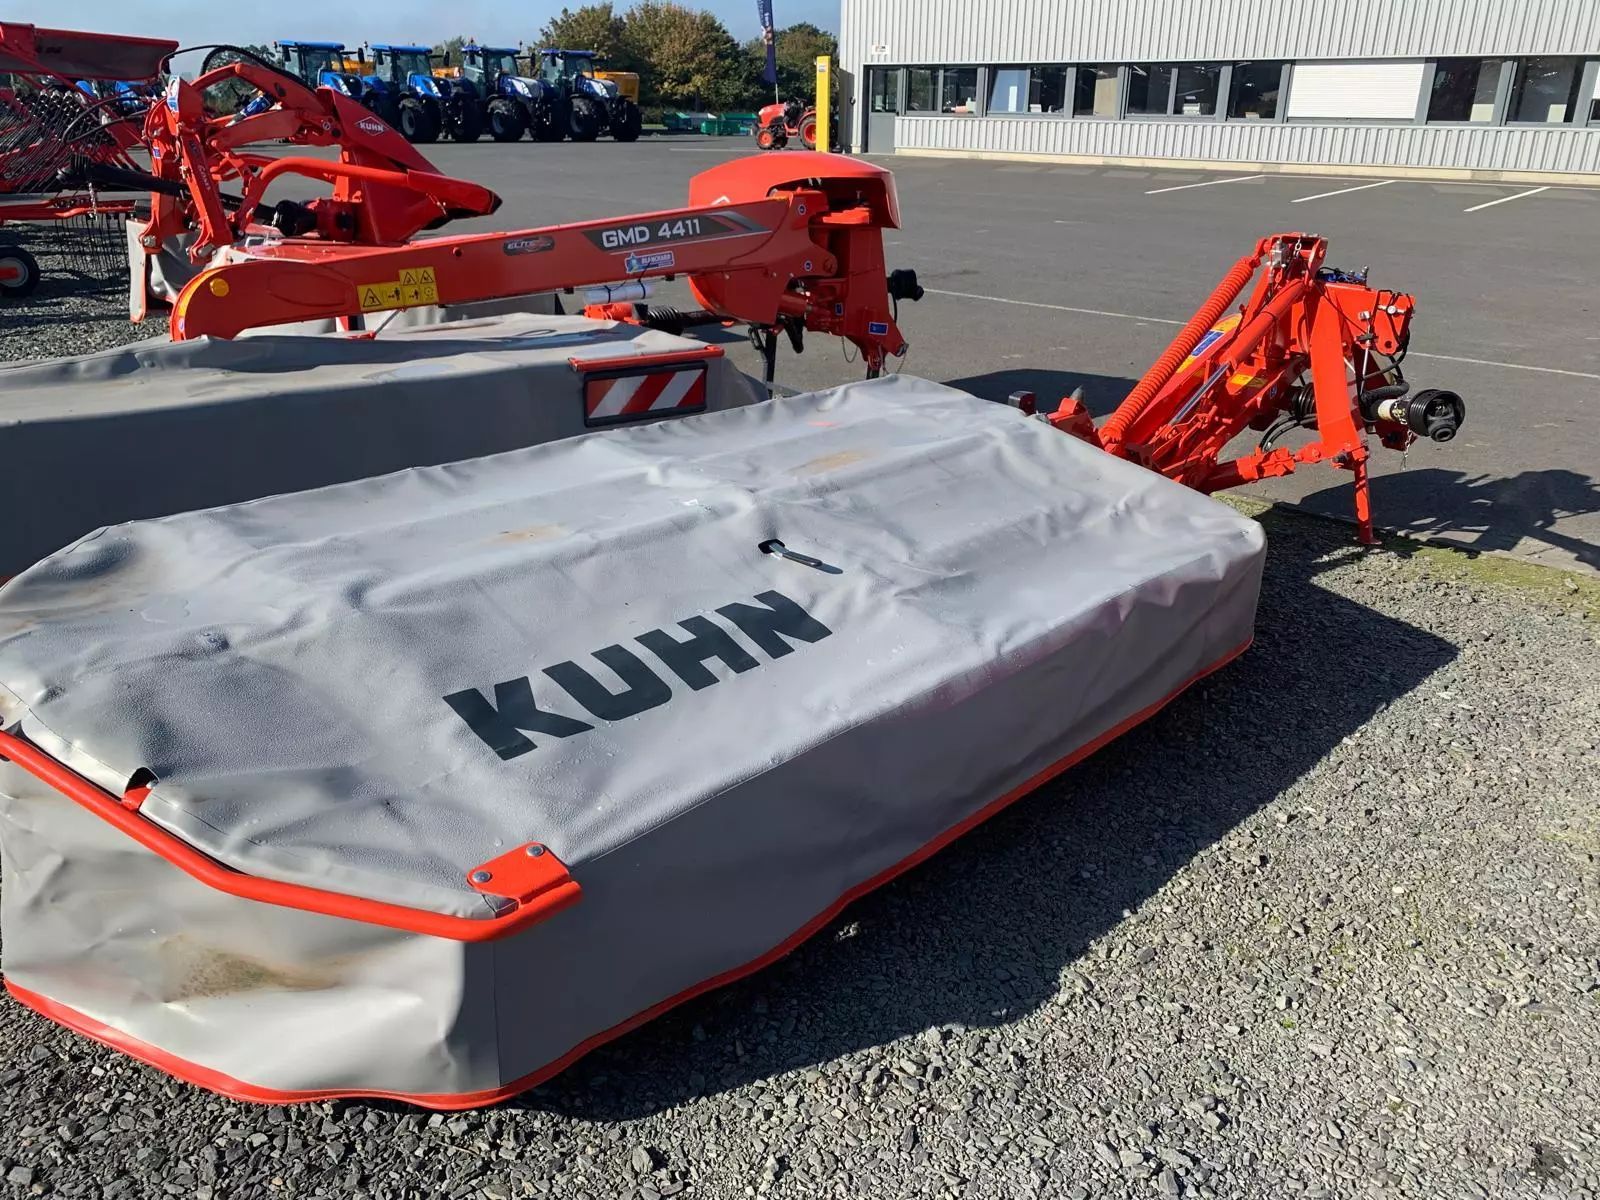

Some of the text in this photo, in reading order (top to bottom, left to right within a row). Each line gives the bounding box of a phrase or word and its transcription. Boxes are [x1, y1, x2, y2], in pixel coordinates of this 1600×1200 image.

[359, 121, 384, 132] KUHN
[602, 218, 700, 248] GMD 4411
[442, 589, 833, 761] KUHN
